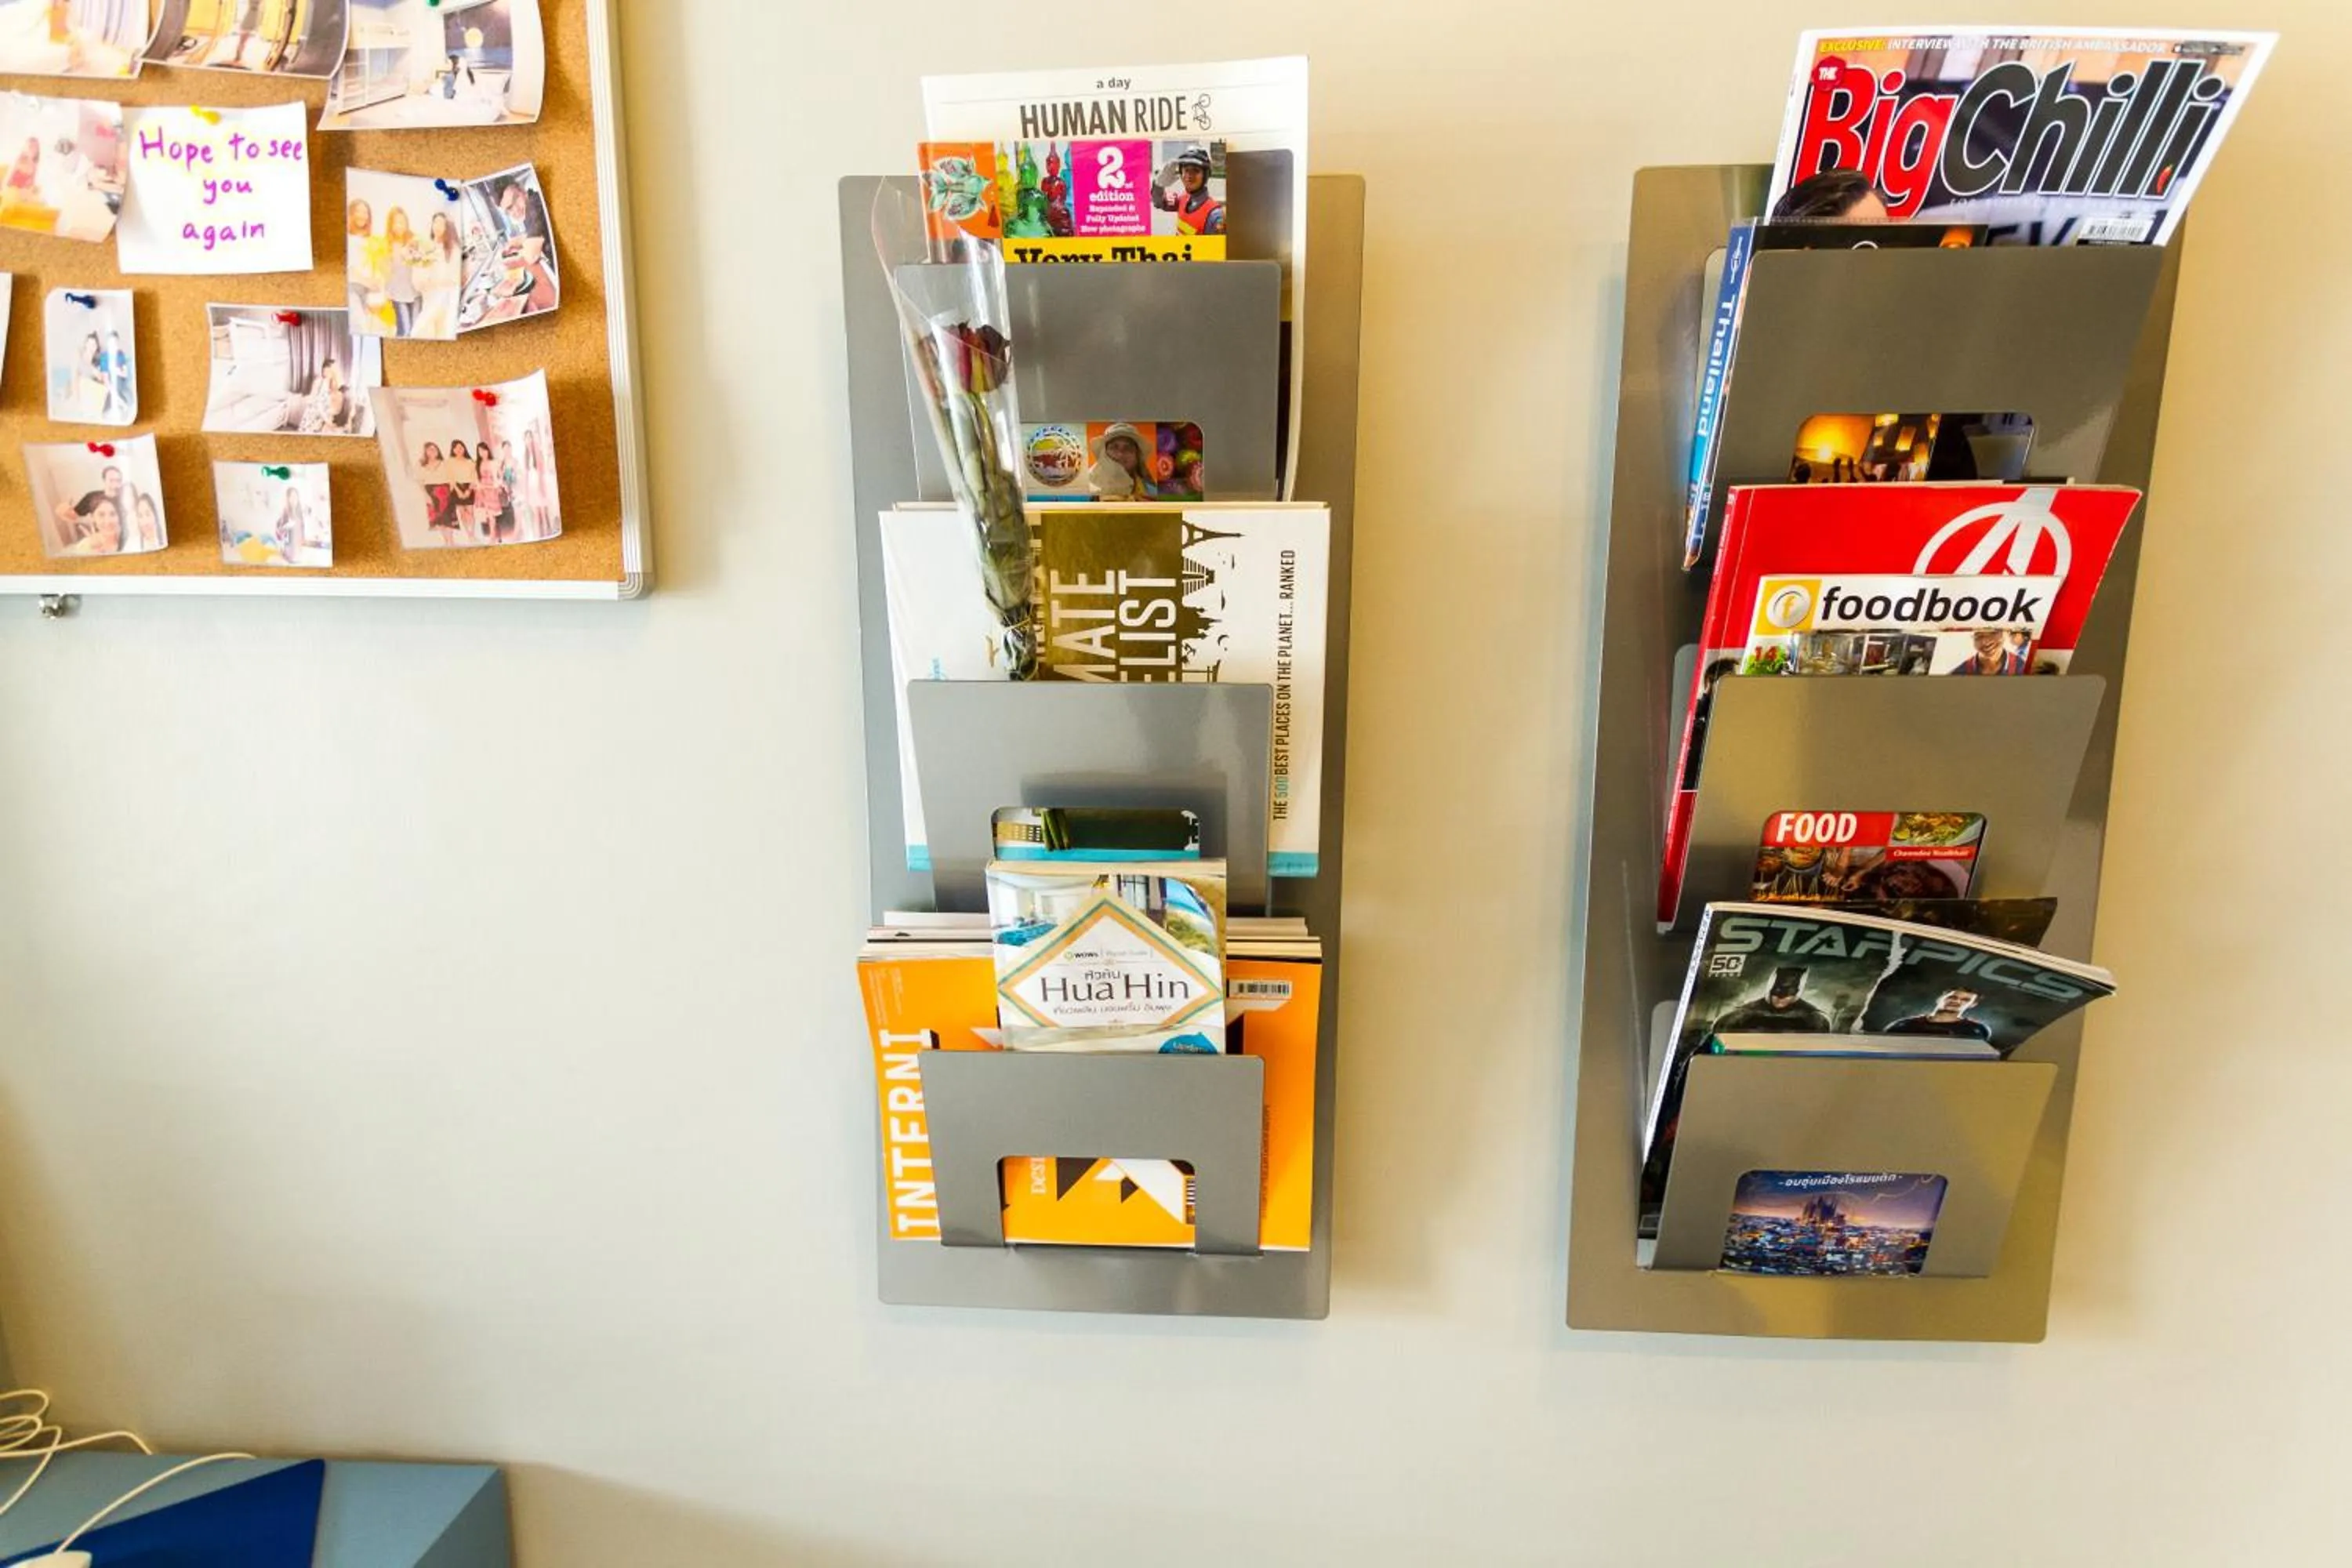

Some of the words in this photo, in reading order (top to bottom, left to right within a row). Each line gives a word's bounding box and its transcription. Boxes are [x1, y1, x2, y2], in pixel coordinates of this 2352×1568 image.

[1992, 38, 2017, 49] THE
[1096, 80, 1104, 89] a
[1108, 77, 1131, 90] day
[1818, 66, 1837, 80] THE
[1019, 99, 1127, 139] HUMAN
[1134, 96, 1188, 132] RIDE
[140, 126, 213, 172] Hope
[228, 132, 260, 160] to
[267, 140, 303, 160] see
[202, 179, 252, 205] you
[1089, 190, 1135, 201] edition
[183, 221, 265, 250] again
[1697, 294, 1736, 437] Thailand
[1279, 550, 1295, 600] RANKED
[1821, 586, 2042, 622] foodbook
[1277, 660, 1291, 681] THE
[1276, 684, 1290, 700] ON
[1275, 702, 1290, 746] PLACES
[1275, 747, 1289, 775] BEST
[1275, 776, 1288, 799] 500
[1273, 800, 1287, 821] THE
[1776, 814, 1857, 844] FOOD
[1040, 977, 1114, 1003] Hua
[1124, 973, 1189, 1000] Hin
